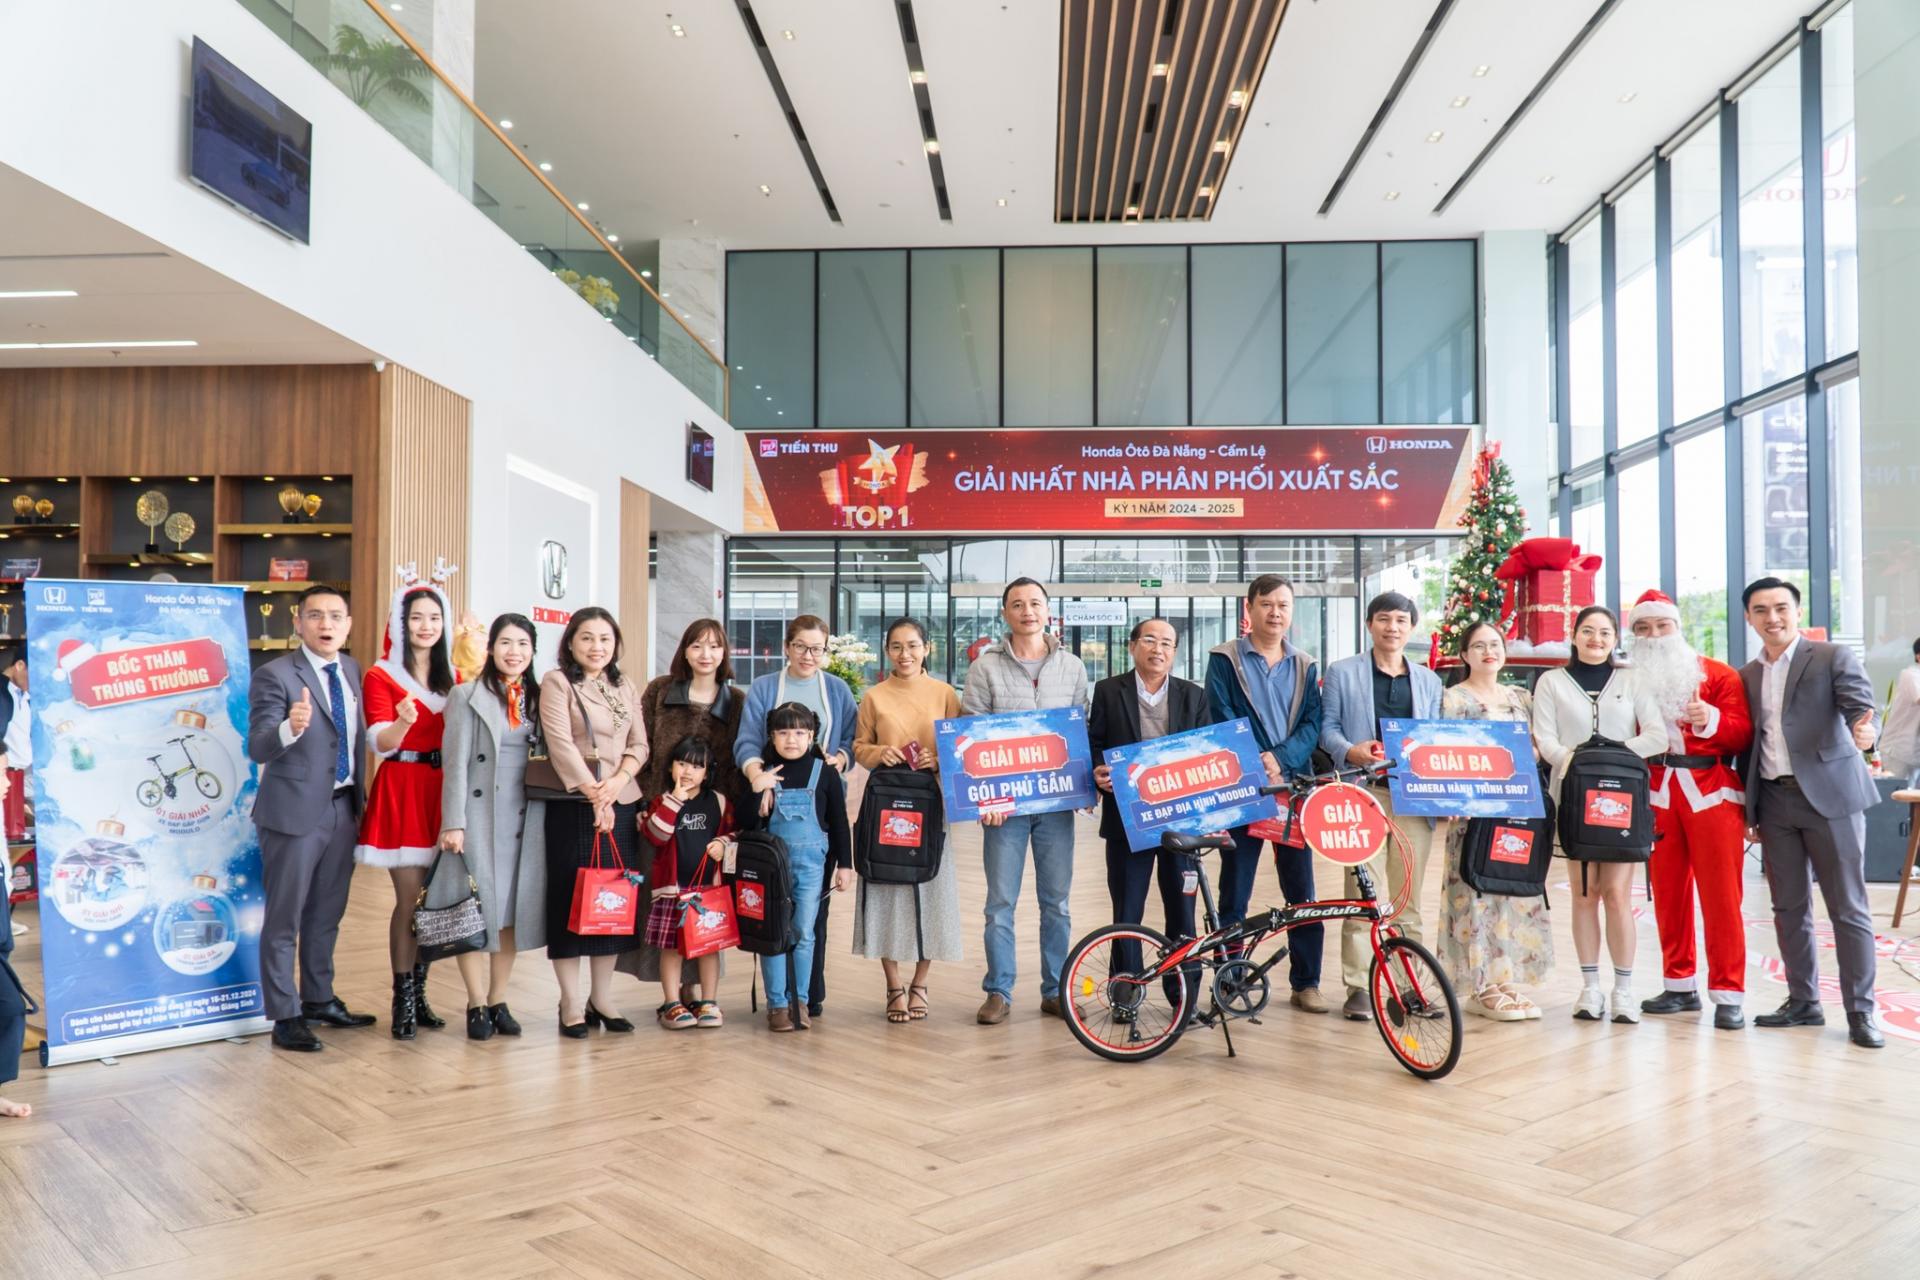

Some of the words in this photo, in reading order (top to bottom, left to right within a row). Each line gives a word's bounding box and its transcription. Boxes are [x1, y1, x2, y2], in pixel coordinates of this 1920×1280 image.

[780, 439, 810, 453] TIẾN
[812, 443, 838, 453] THU
[1082, 446, 1123, 458] Honda
[1125, 442, 1150, 458] Ôtô
[1152, 445, 1170, 457] Đà
[1250, 444, 1266, 460] Lệ
[1389, 440, 1453, 450] HONDA
[954, 465, 1005, 491] GIẢI
[1011, 464, 1077, 491] NHẤT
[1082, 465, 1135, 491] NHÀ
[1141, 465, 1208, 491] PHÂN
[1215, 463, 1273, 491] PHỐI
[1279, 463, 1344, 491] XUẤT
[1349, 461, 1399, 491] SẮC
[842, 505, 893, 527] TOP
[898, 505, 909, 527] 1
[1113, 501, 1129, 514] KỲ
[1132, 504, 1137, 514] 1
[1139, 502, 1167, 514] NĂM
[1169, 504, 1197, 514] 2024
[1207, 504, 1235, 514] 2025
[145, 594, 177, 605] Honda
[106, 653, 142, 677] BỐC
[143, 649, 188, 672] THĂM
[91, 678, 147, 701] TRÚNG
[148, 666, 210, 692] THƯỞNG
[980, 744, 1014, 769] GIẢI
[1429, 750, 1465, 771] GIẢI
[1468, 754, 1493, 771] BA
[1147, 769, 1183, 796] GIẢI
[1184, 756, 1230, 787] NHẤT
[967, 780, 996, 802] GÓI
[1000, 775, 1033, 798] PHỦ
[1406, 783, 1446, 793] CAMERA
[1447, 781, 1473, 794] HÀNH
[1475, 781, 1504, 794] TRÌNH
[1140, 811, 1154, 823] XE
[1154, 805, 1174, 820] ĐẠP
[1175, 801, 1193, 815] ĐỊA
[1193, 796, 1217, 811] HÌNH
[1218, 785, 1257, 804] MODULO
[1323, 799, 1362, 825] GIẢI
[678, 812, 707, 831] AIR
[1320, 823, 1371, 850] NHẤT
[1293, 905, 1362, 918] Modulo
